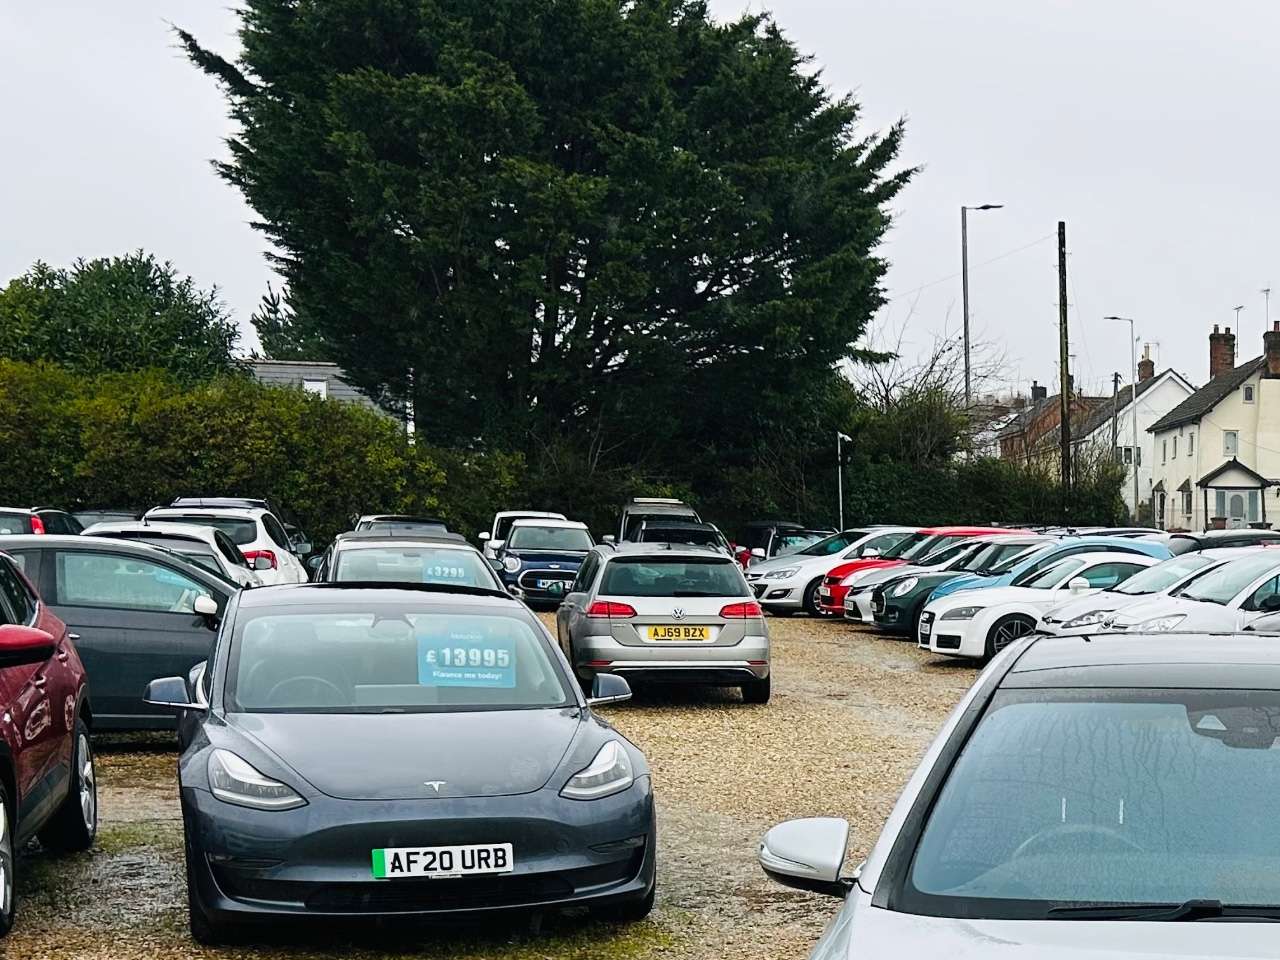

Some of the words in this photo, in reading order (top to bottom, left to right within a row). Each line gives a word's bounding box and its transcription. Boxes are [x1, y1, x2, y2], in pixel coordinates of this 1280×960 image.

[653, 627, 681, 638] AJ69
[684, 627, 705, 638] BZX
[390, 850, 454, 872] AF20
[461, 847, 507, 870] URB
